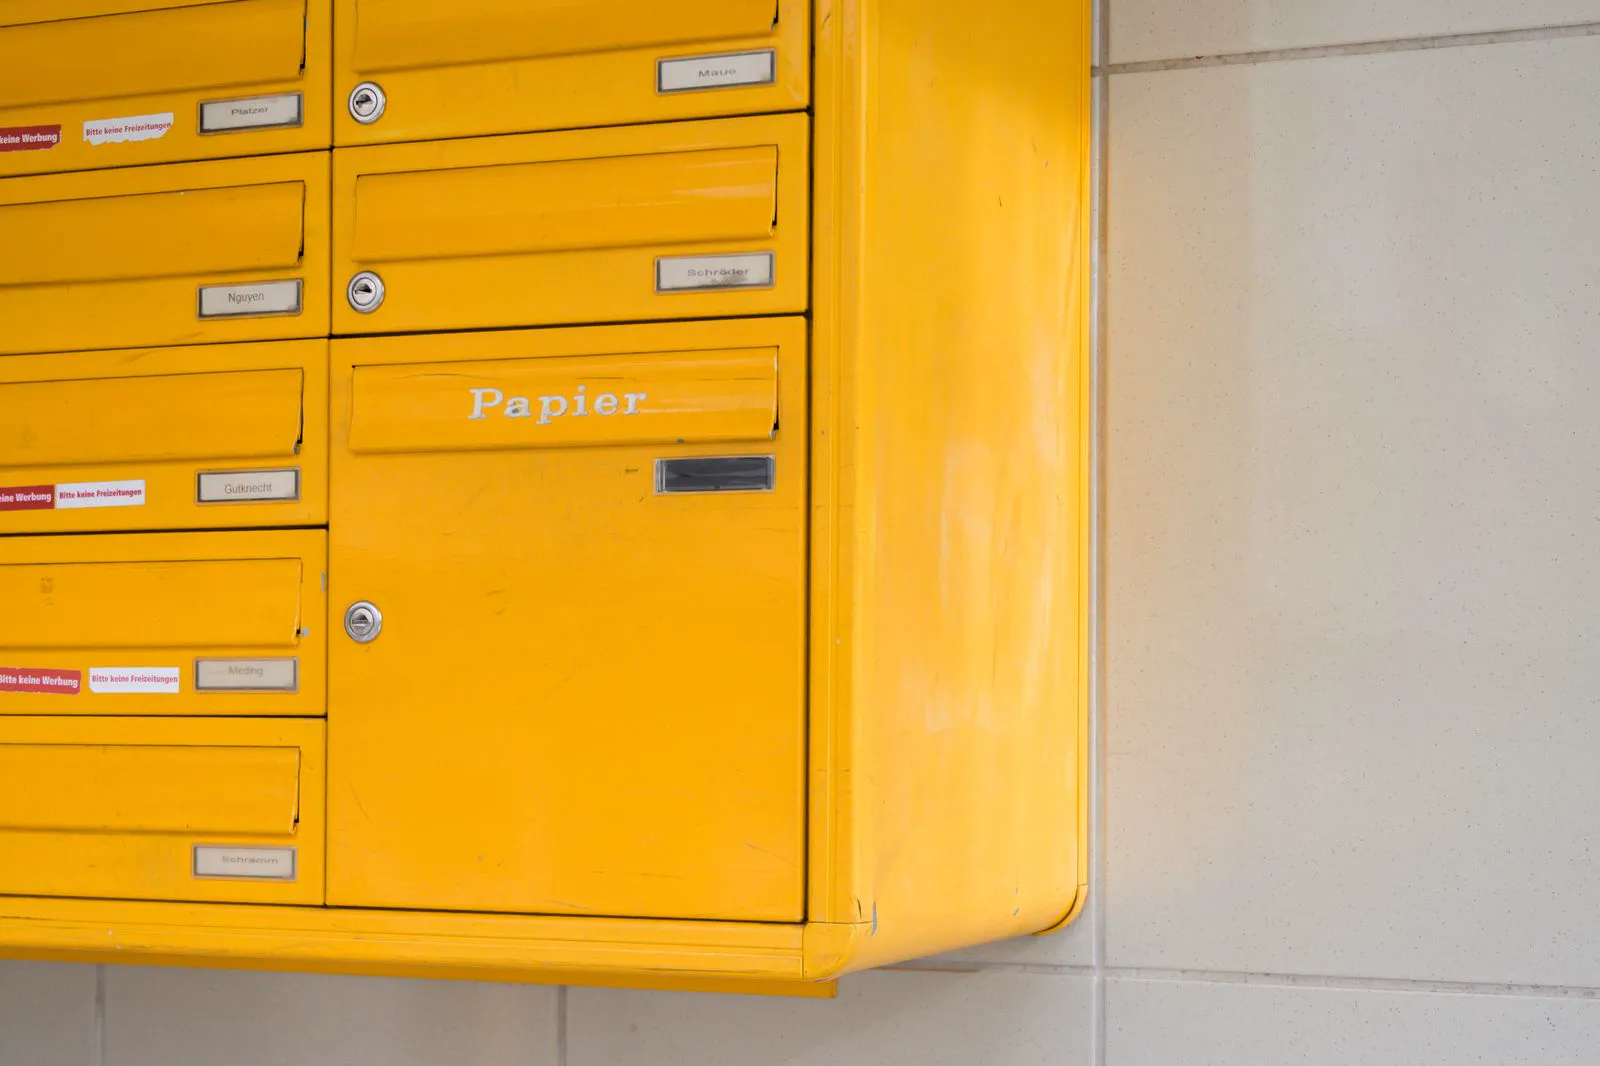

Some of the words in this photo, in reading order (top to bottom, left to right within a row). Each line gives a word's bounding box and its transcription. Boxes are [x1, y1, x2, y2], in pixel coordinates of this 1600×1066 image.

[698, 68, 737, 77] Maue
[231, 107, 269, 116] Platzer
[86, 127, 103, 137] Bitte
[104, 125, 123, 136] keine
[124, 121, 172, 134] Freizeitungen
[22, 133, 58, 143] Werbung
[228, 292, 264, 304] Nguyen
[468, 385, 647, 424] Papier
[59, 490, 75, 500] Bitte
[77, 489, 95, 499] keine
[96, 487, 142, 499] Freizeitungen
[224, 482, 272, 494] Gutknecht
[15, 491, 51, 503] Werbung
[228, 665, 264, 678] Meding
[19, 675, 40, 685] keine
[42, 676, 78, 689] Werbung
[92, 673, 108, 683] Bitte
[110, 673, 129, 683] keine
[130, 673, 178, 685] Freizeitungen
